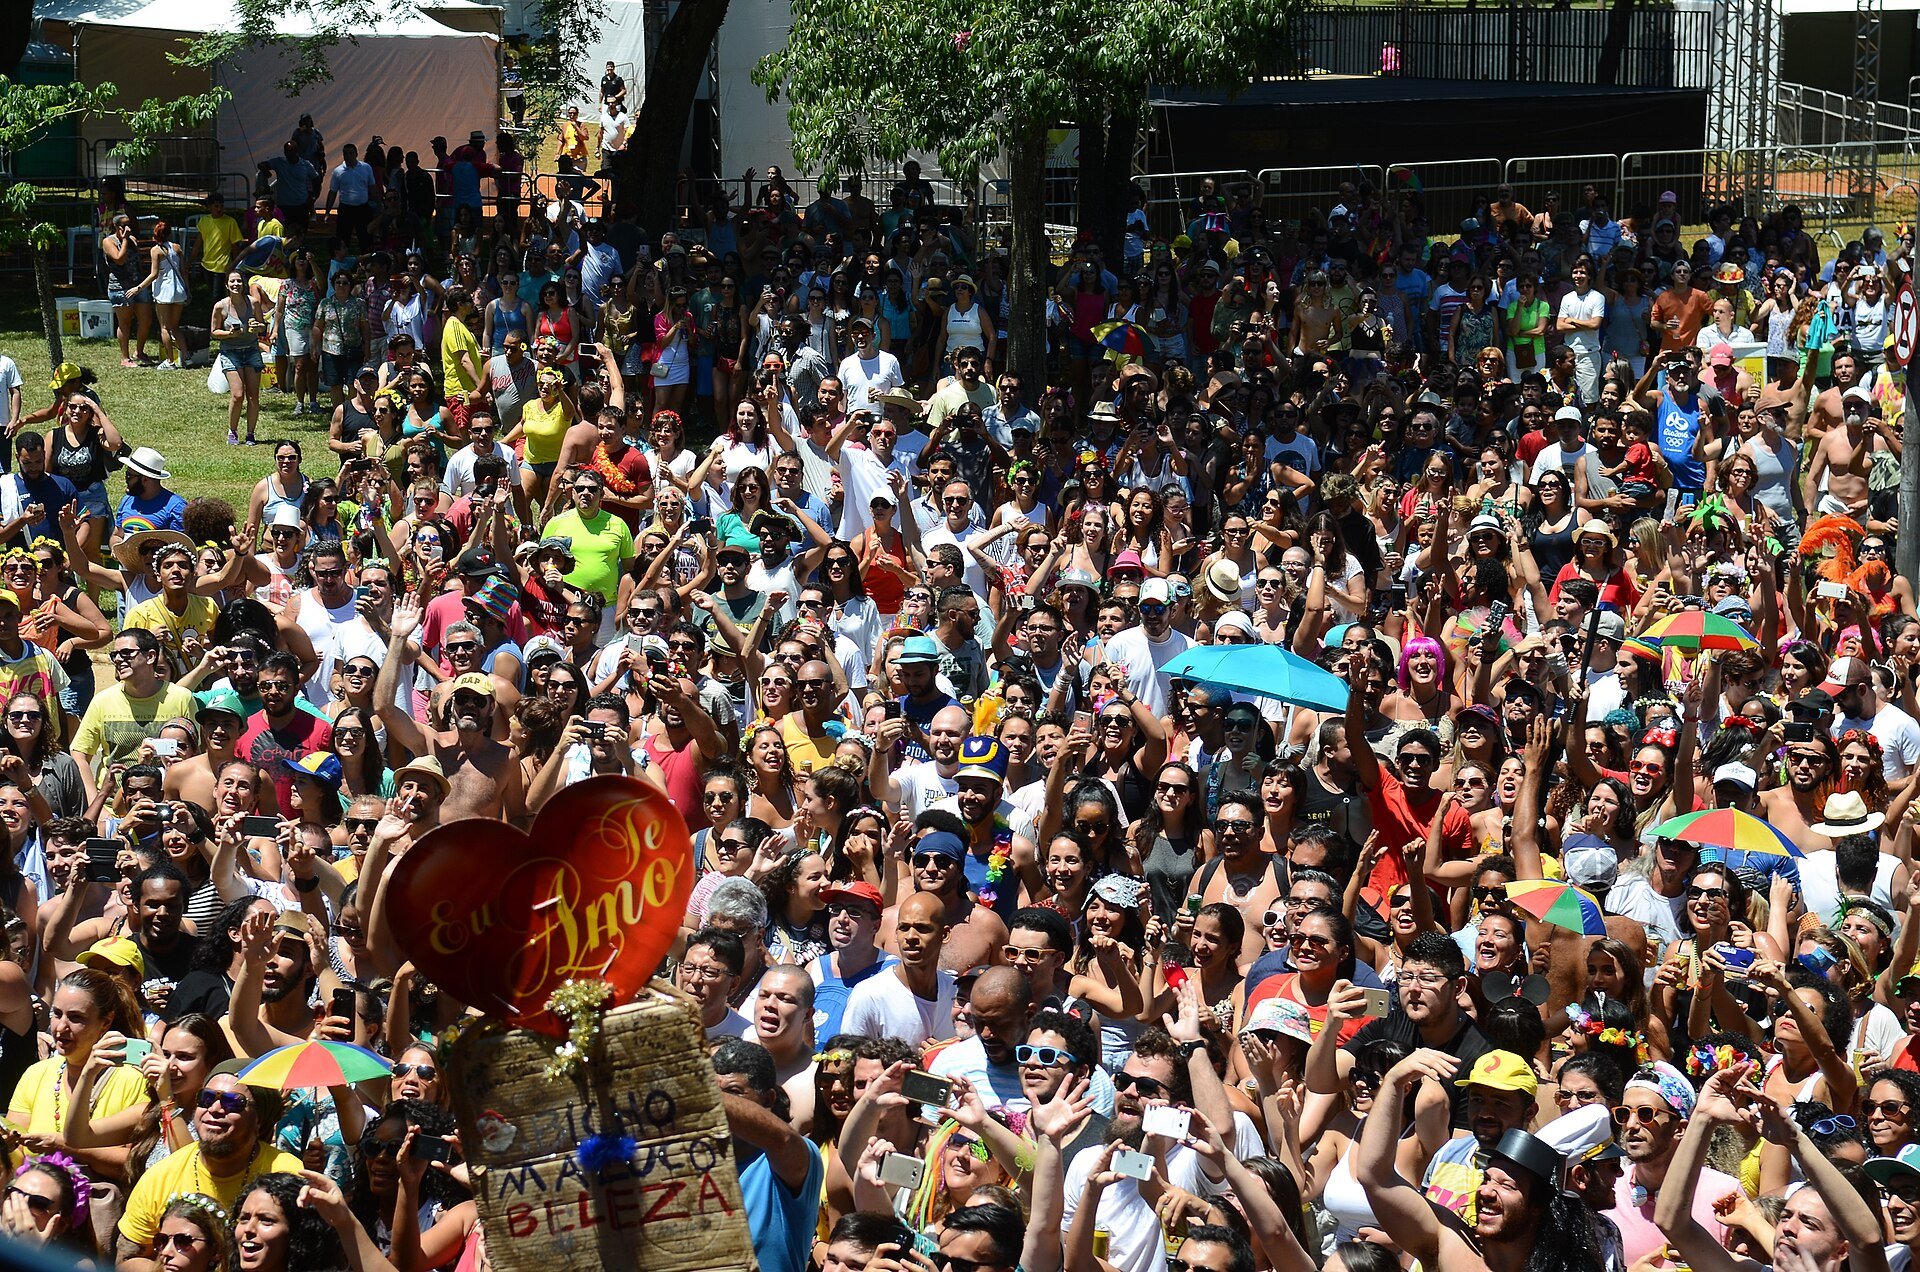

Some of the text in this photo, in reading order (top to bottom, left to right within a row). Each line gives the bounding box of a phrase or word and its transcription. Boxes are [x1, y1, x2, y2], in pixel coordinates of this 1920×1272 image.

[586, 794, 667, 882] Te
[430, 853, 685, 997] Eu Amo
[506, 1171, 735, 1238] BELEZA
